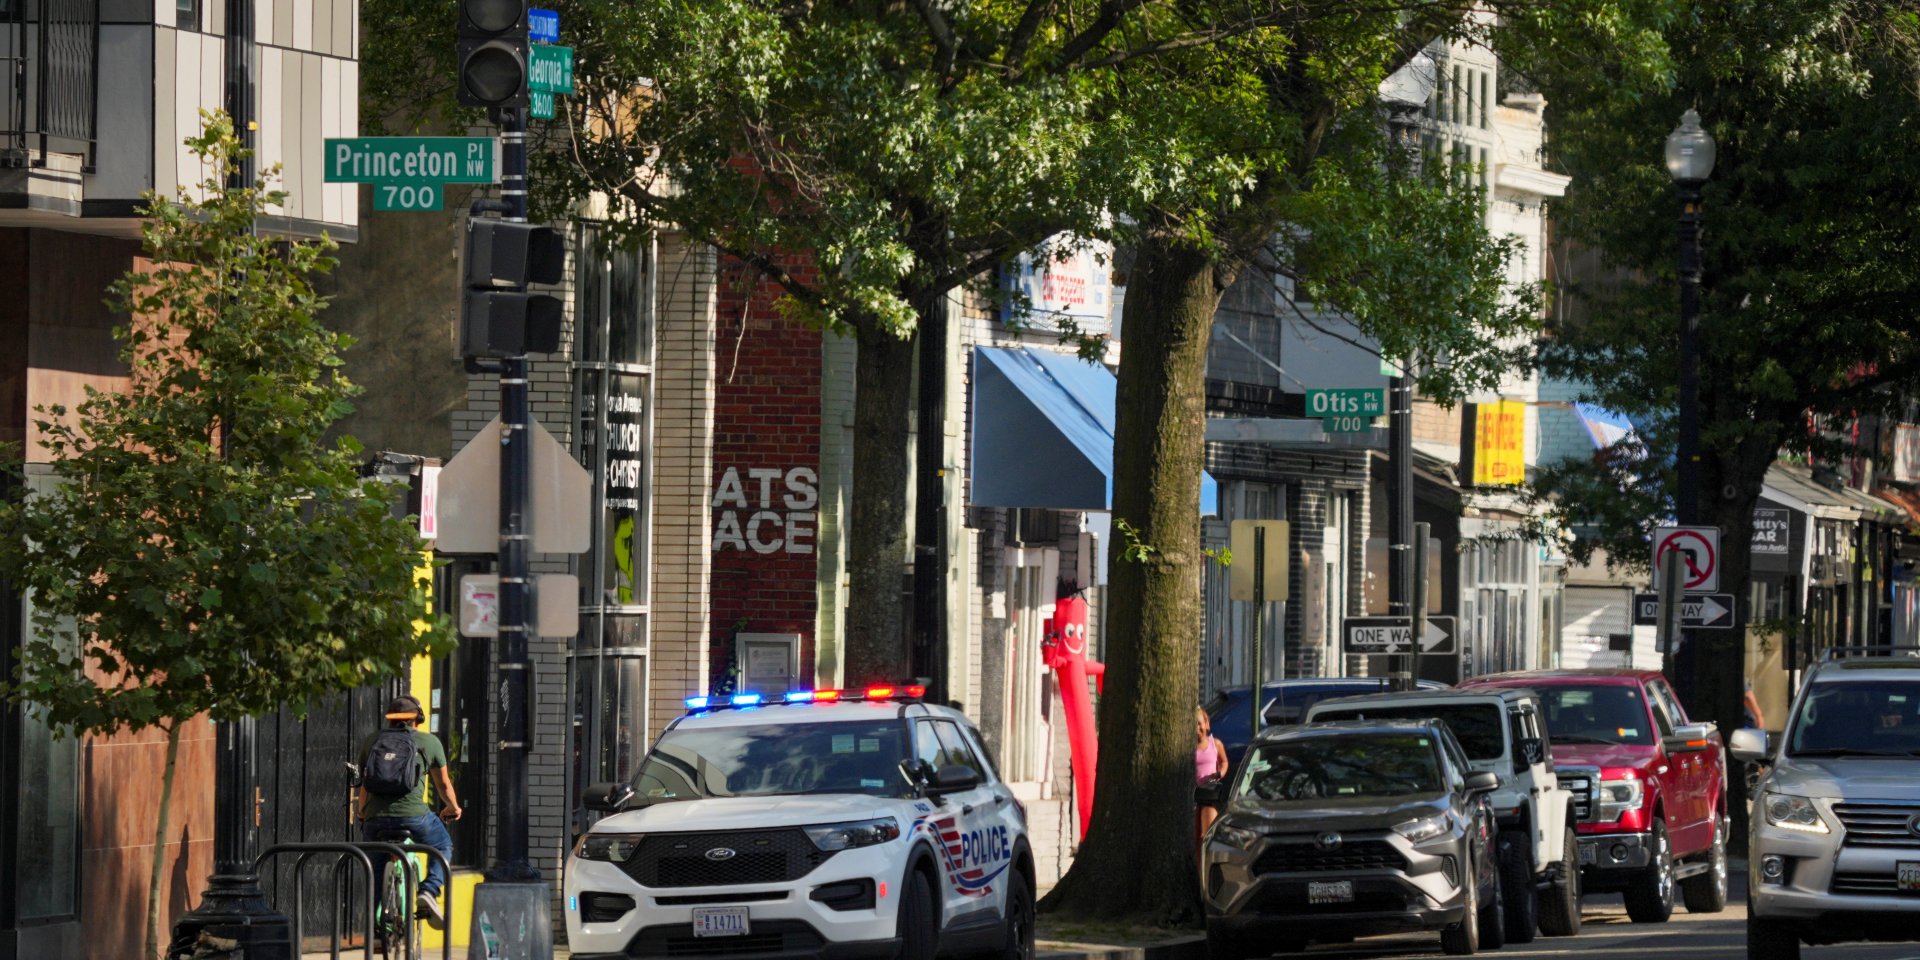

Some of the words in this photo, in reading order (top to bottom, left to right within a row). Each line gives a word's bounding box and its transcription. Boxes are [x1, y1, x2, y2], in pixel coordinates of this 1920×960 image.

[529, 48, 562, 91] Georgia
[533, 93, 552, 117] 3600
[336, 143, 457, 177] Princeton
[466, 160, 484, 177] NW
[383, 186, 434, 208] 700
[1313, 392, 1359, 413] Otis
[1364, 392, 1378, 402] PL
[1364, 402, 1379, 412] NW
[1333, 416, 1361, 431] 700
[610, 459, 641, 489] CHRIST
[711, 466, 818, 510] ATS
[711, 510, 816, 554] ACE
[1753, 519, 1787, 532] itty's
[1752, 531, 1777, 542] AR
[1355, 629, 1385, 643] ONE
[1391, 629, 1412, 643] WA
[961, 825, 1011, 867] POLICE
[714, 915, 743, 929] 14711
